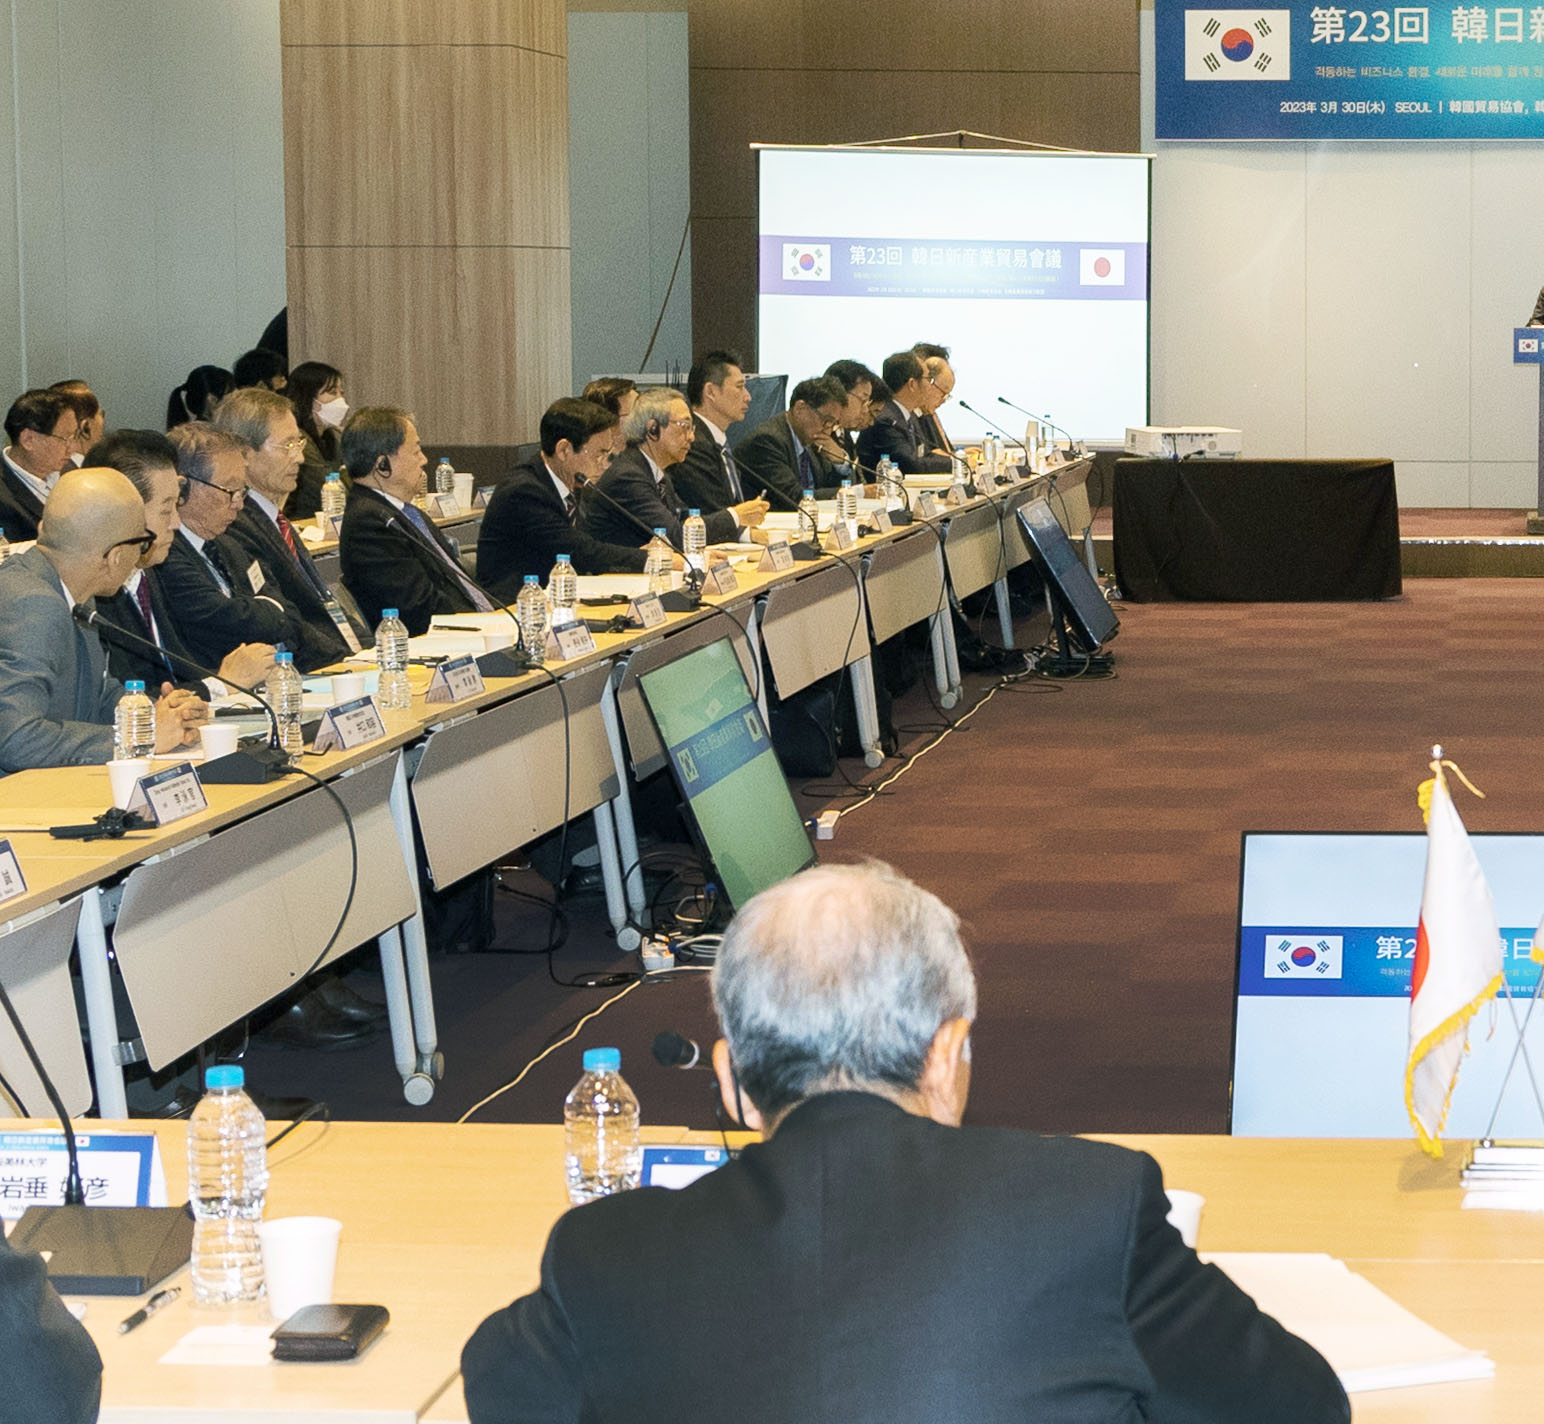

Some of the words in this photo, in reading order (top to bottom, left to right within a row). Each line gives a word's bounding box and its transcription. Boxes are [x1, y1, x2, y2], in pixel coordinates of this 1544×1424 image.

[1309, 6, 1429, 45] 第23回
[1314, 66, 1356, 79] 격동하는
[1361, 67, 1403, 78] 비즈니스
[1280, 101, 1317, 114] 2023年
[1320, 101, 1338, 114] 3月
[1341, 100, 1386, 115] 30日(木)
[1395, 102, 1433, 114] SEOUL
[849, 245, 902, 267] 第23回
[1375, 935, 1417, 960] 第2
[0, 1175, 48, 1199] 岩垂
